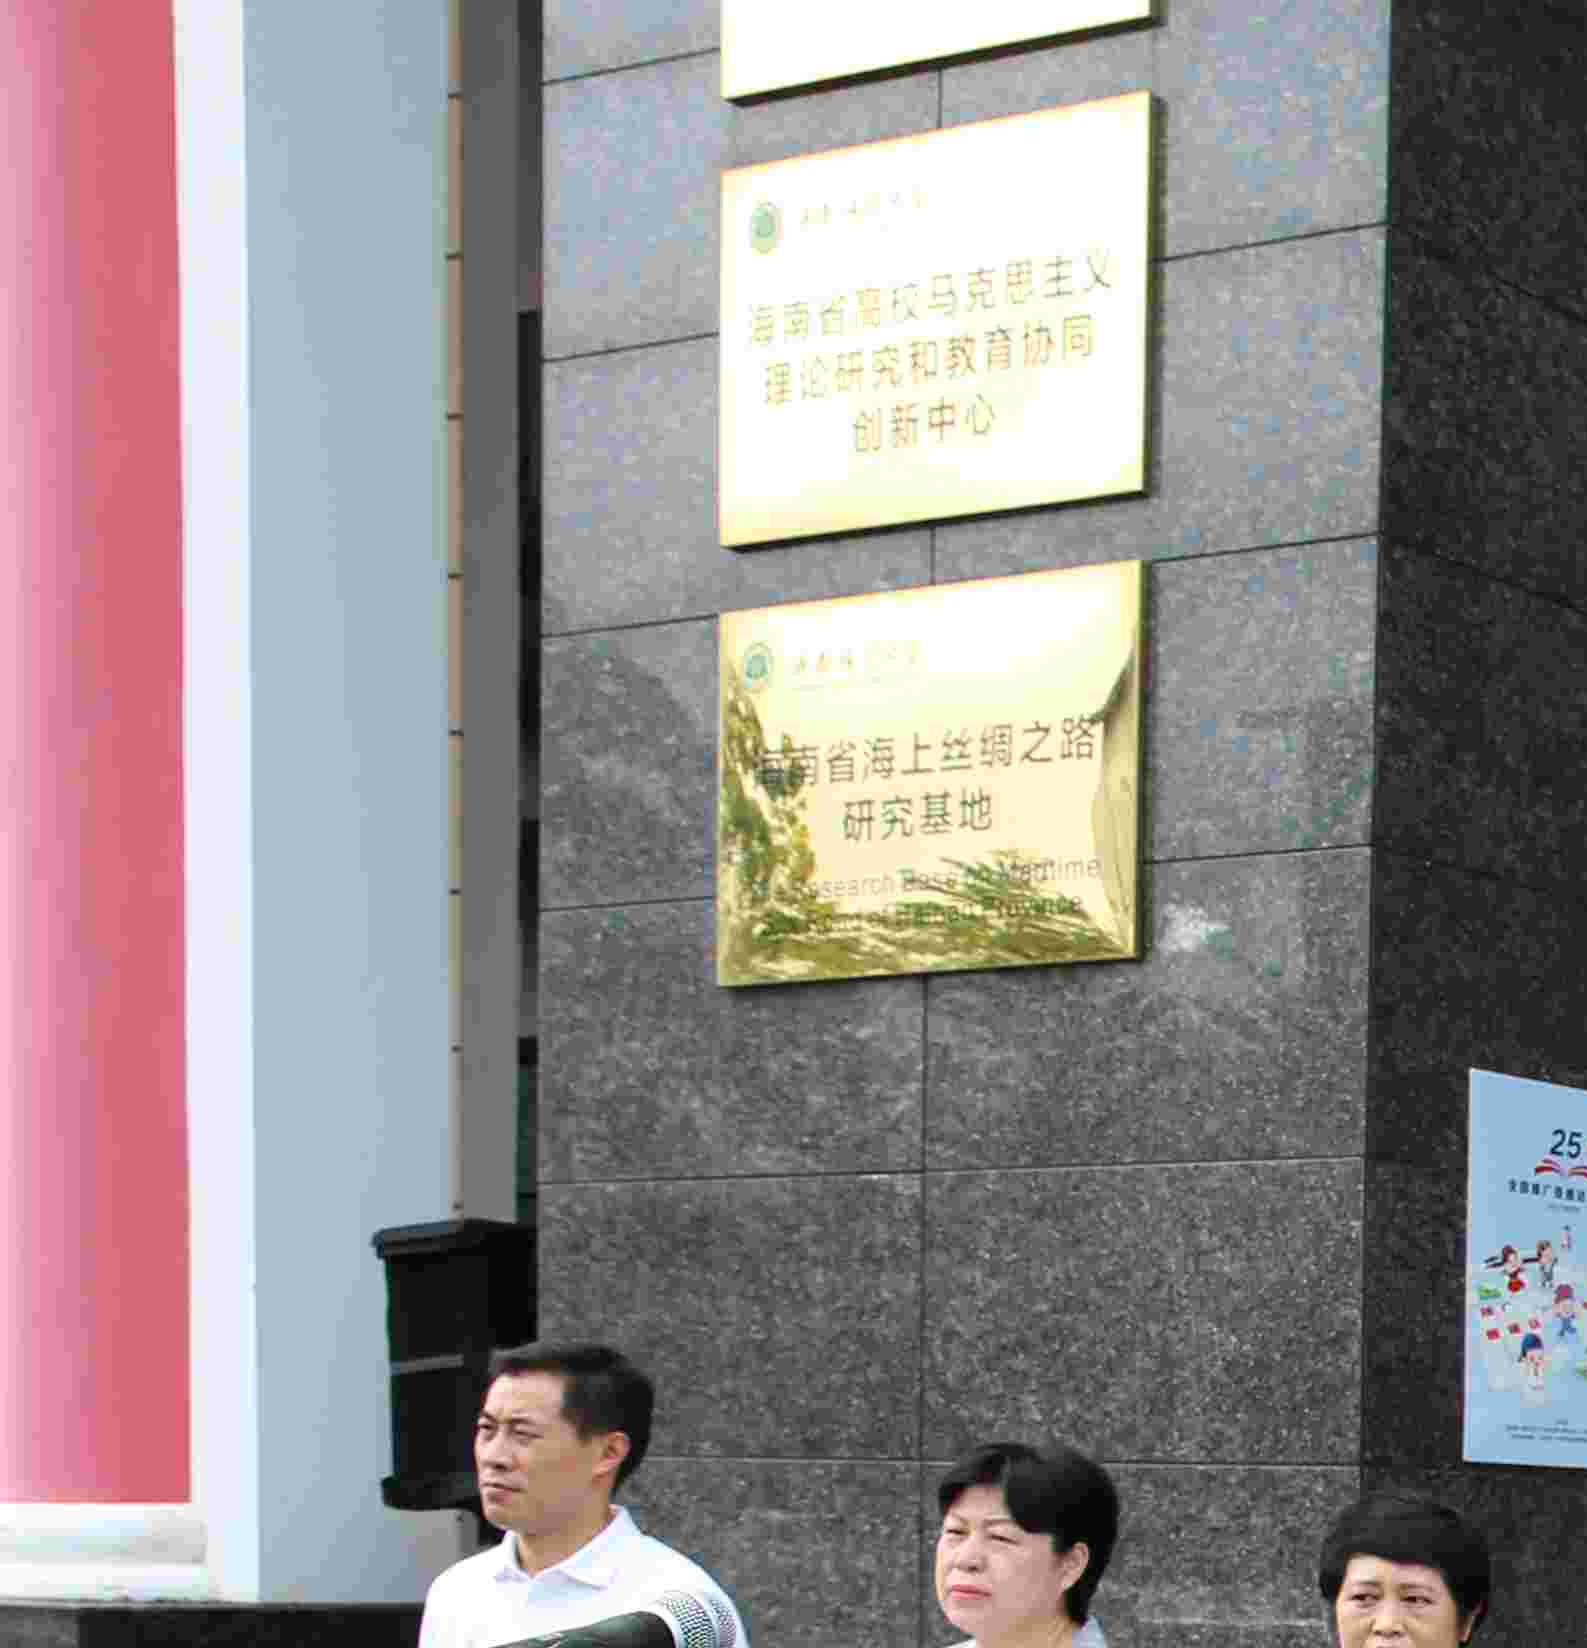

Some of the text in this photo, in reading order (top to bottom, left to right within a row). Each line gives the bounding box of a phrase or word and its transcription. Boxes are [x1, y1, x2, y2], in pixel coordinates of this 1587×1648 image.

[853, 393, 996, 453] 创新中心
[753, 716, 1096, 788] 海南省海上丝绸之路
[842, 787, 994, 842] 研究基地
